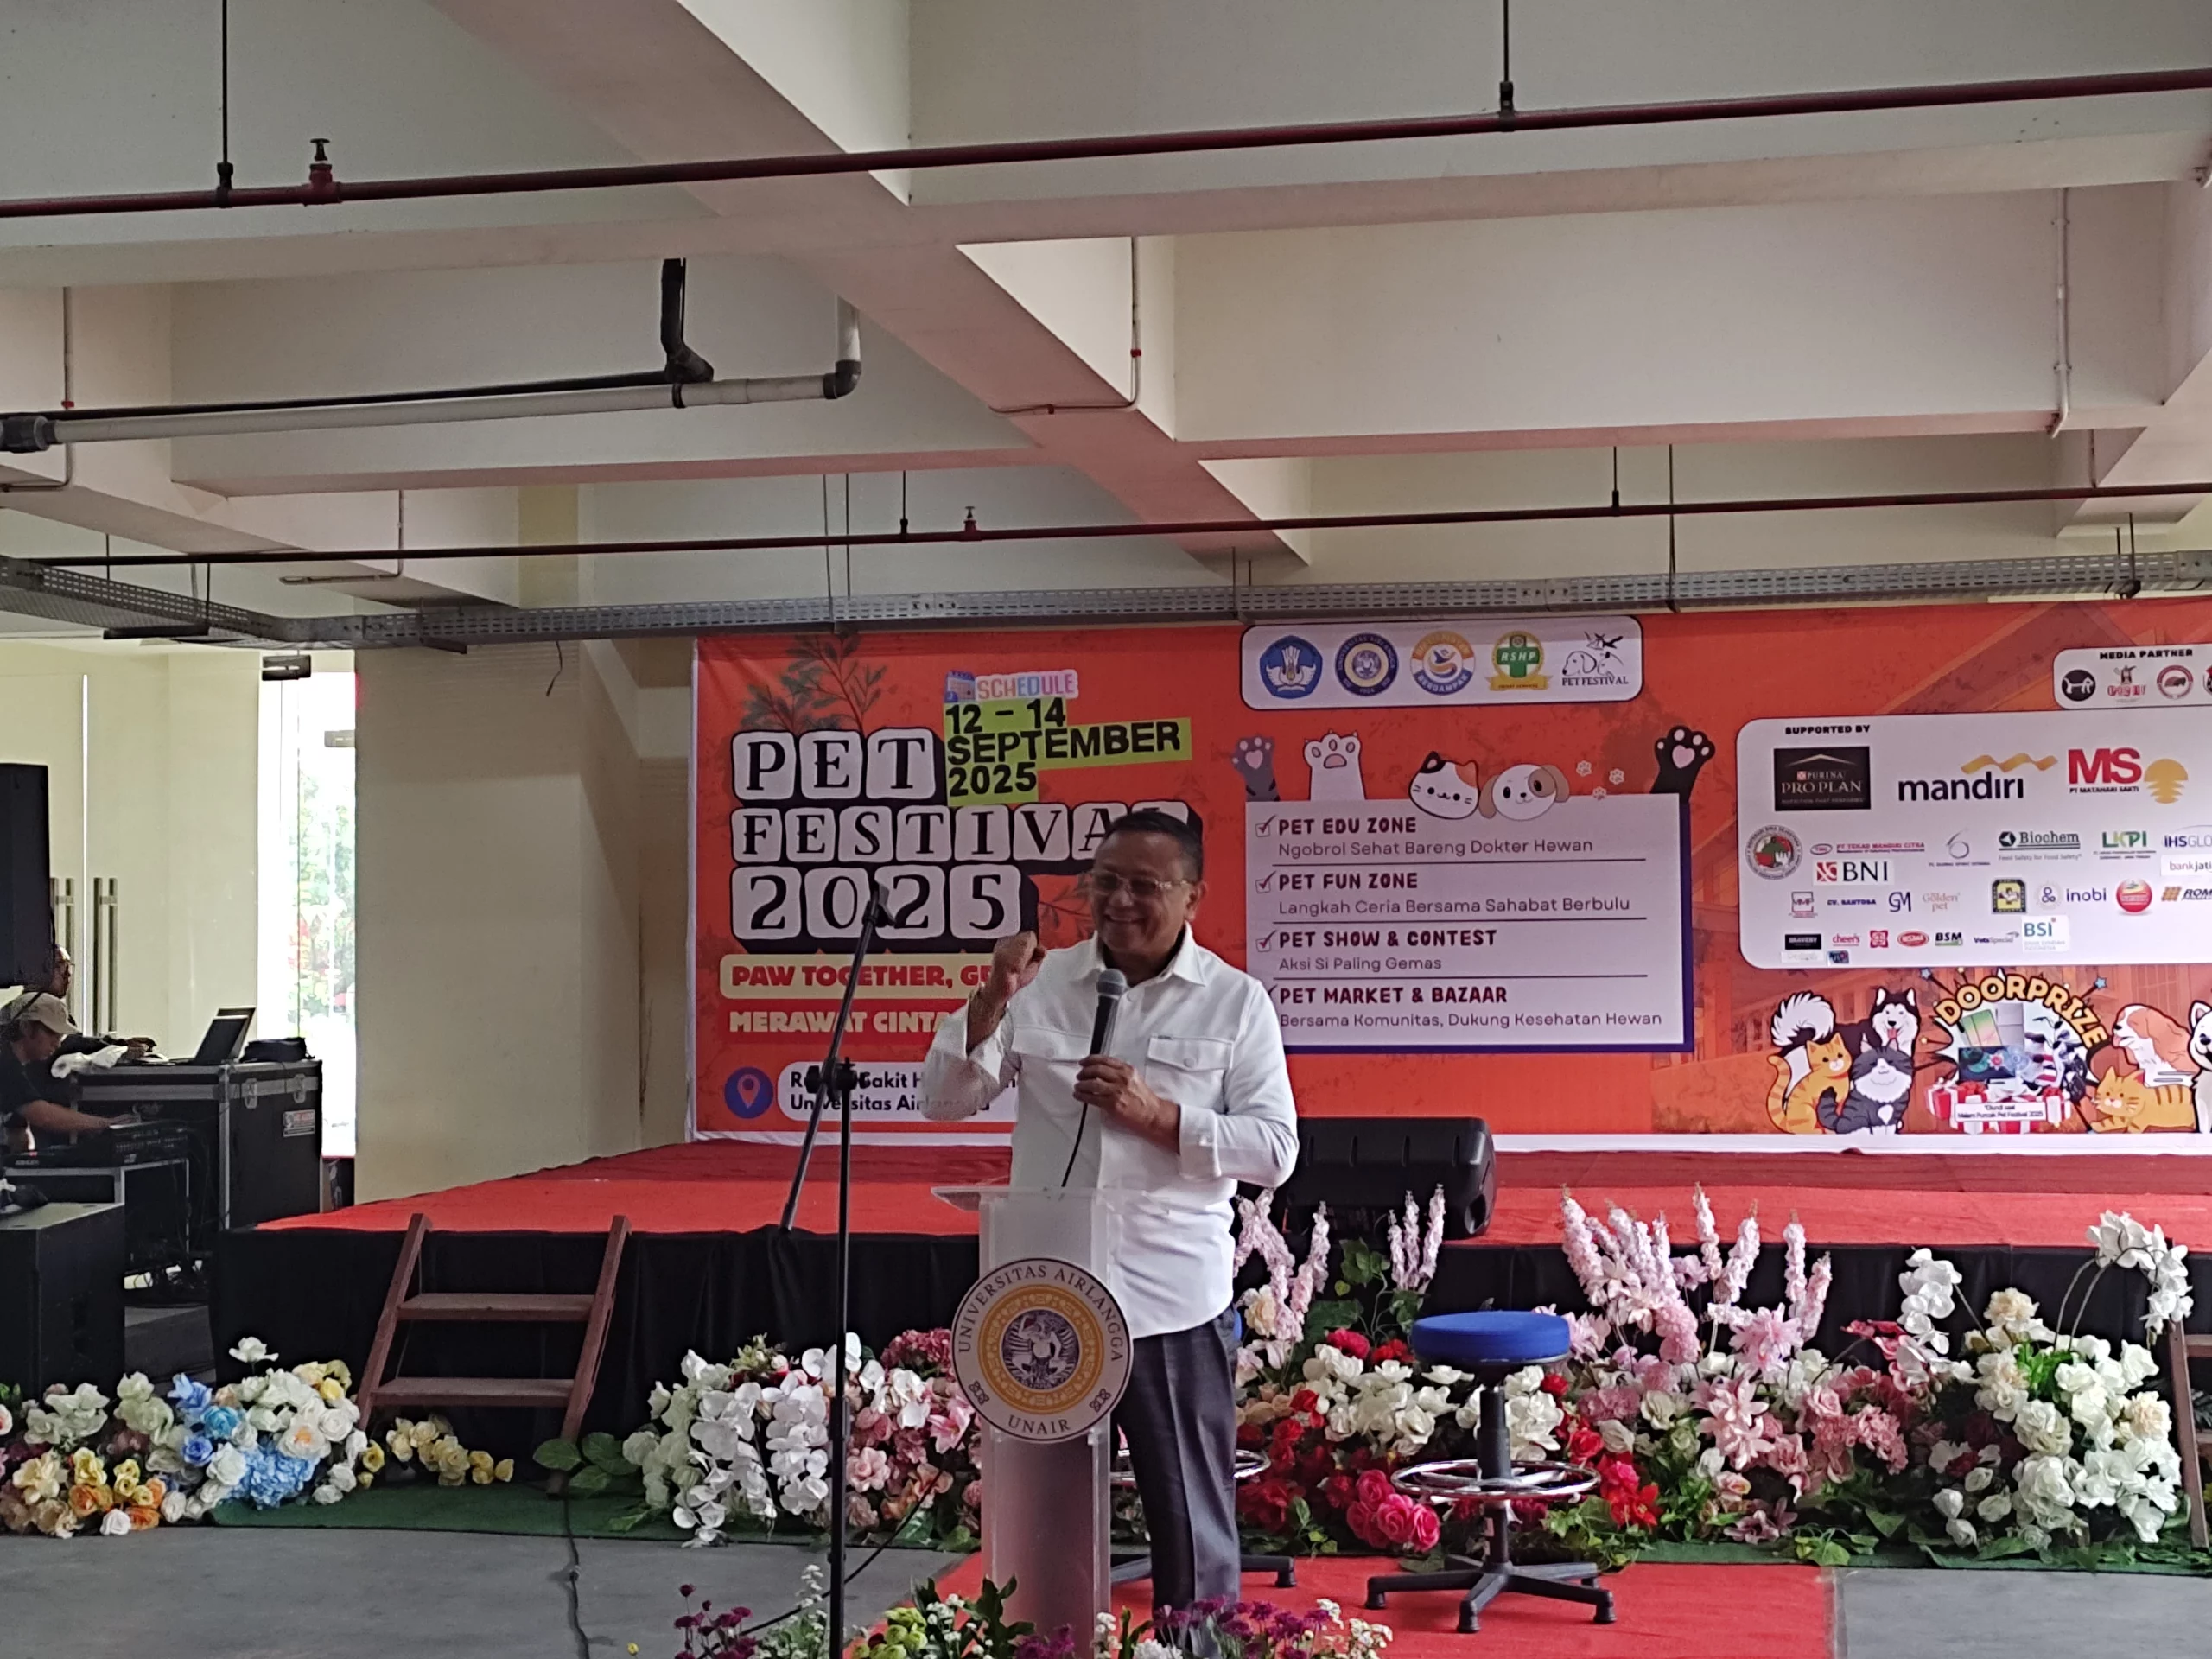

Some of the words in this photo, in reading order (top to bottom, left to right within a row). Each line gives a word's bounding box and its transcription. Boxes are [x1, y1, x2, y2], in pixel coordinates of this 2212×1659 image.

[1501, 651, 1536, 662] RSHP
[2139, 649, 2193, 658] PARTNER
[977, 673, 1076, 699] SCHEDULE
[1562, 677, 1580, 686] PET
[1582, 676, 1629, 686] FESTIVAL
[945, 703, 982, 734] 12
[1027, 696, 1066, 728] 14
[1785, 726, 1852, 734] SUPPORTED
[948, 721, 1181, 766] SEPTEMBER
[746, 737, 925, 791] PET
[2068, 747, 2142, 785] MS
[949, 761, 1037, 797] 2025
[1898, 772, 2024, 802] mandiri
[742, 807, 1160, 856] FESTIVA
[1279, 818, 1315, 836] PET
[1323, 817, 1360, 835] EDU
[1367, 817, 1417, 833] ZONE
[2019, 830, 2080, 843] Biochem
[2102, 830, 2147, 848] LKPI
[1279, 842, 1345, 859] Ngobrol
[1351, 842, 1400, 855] Sehat
[1405, 841, 1465, 857] Bareng
[1471, 839, 1529, 854] Dokter
[1534, 839, 1593, 852] Hewan
[1842, 861, 1888, 881] BNI
[2169, 861, 2212, 872] bankjati
[1279, 874, 1315, 891] PET
[1323, 873, 1361, 890] FUN
[1368, 872, 1418, 889] ZONE
[750, 874, 1006, 931] 2025
[2066, 888, 2107, 902] inobi
[2183, 888, 2212, 899] ROM
[1279, 899, 1350, 917] Langkah
[1355, 899, 1401, 913] Ceria
[1406, 899, 1480, 912] Bersama
[1485, 897, 1557, 912] Sahabat
[1563, 896, 1630, 911] Berbulu
[1280, 931, 1316, 948] PET
[1323, 931, 1380, 947] SHOW
[1387, 931, 1399, 946] &
[1407, 929, 1497, 946] CONTEST
[1936, 932, 1961, 941] BSM
[2024, 922, 2052, 937] BSI
[1279, 957, 1311, 970] Aksi
[1315, 957, 1329, 970] Si
[1333, 957, 1381, 972] Paling
[1385, 957, 1442, 969] Gemas
[732, 965, 796, 987] PAW
[960, 965, 993, 986] GR
[1280, 987, 1316, 1004] PET
[1324, 987, 1404, 1004] MARKET
[1412, 987, 1424, 1003] &
[1432, 986, 1508, 1003] BAZAAR
[1280, 1014, 1349, 1027] Bersama
[1354, 1014, 1444, 1028] Komunitas,
[1448, 1013, 1510, 1028] Dukung
[1515, 1013, 1601, 1026] Kesehatan
[1606, 1013, 1662, 1025] Hewan
[1936, 975, 2108, 1048] DOORPRIZE
[791, 1093, 892, 1111] Unvesitas
[959, 1265, 1046, 1352] UNIVERSITAS
[1054, 1268, 1123, 1361] AIRLANGGA
[1008, 1414, 1071, 1434] UNAIR
